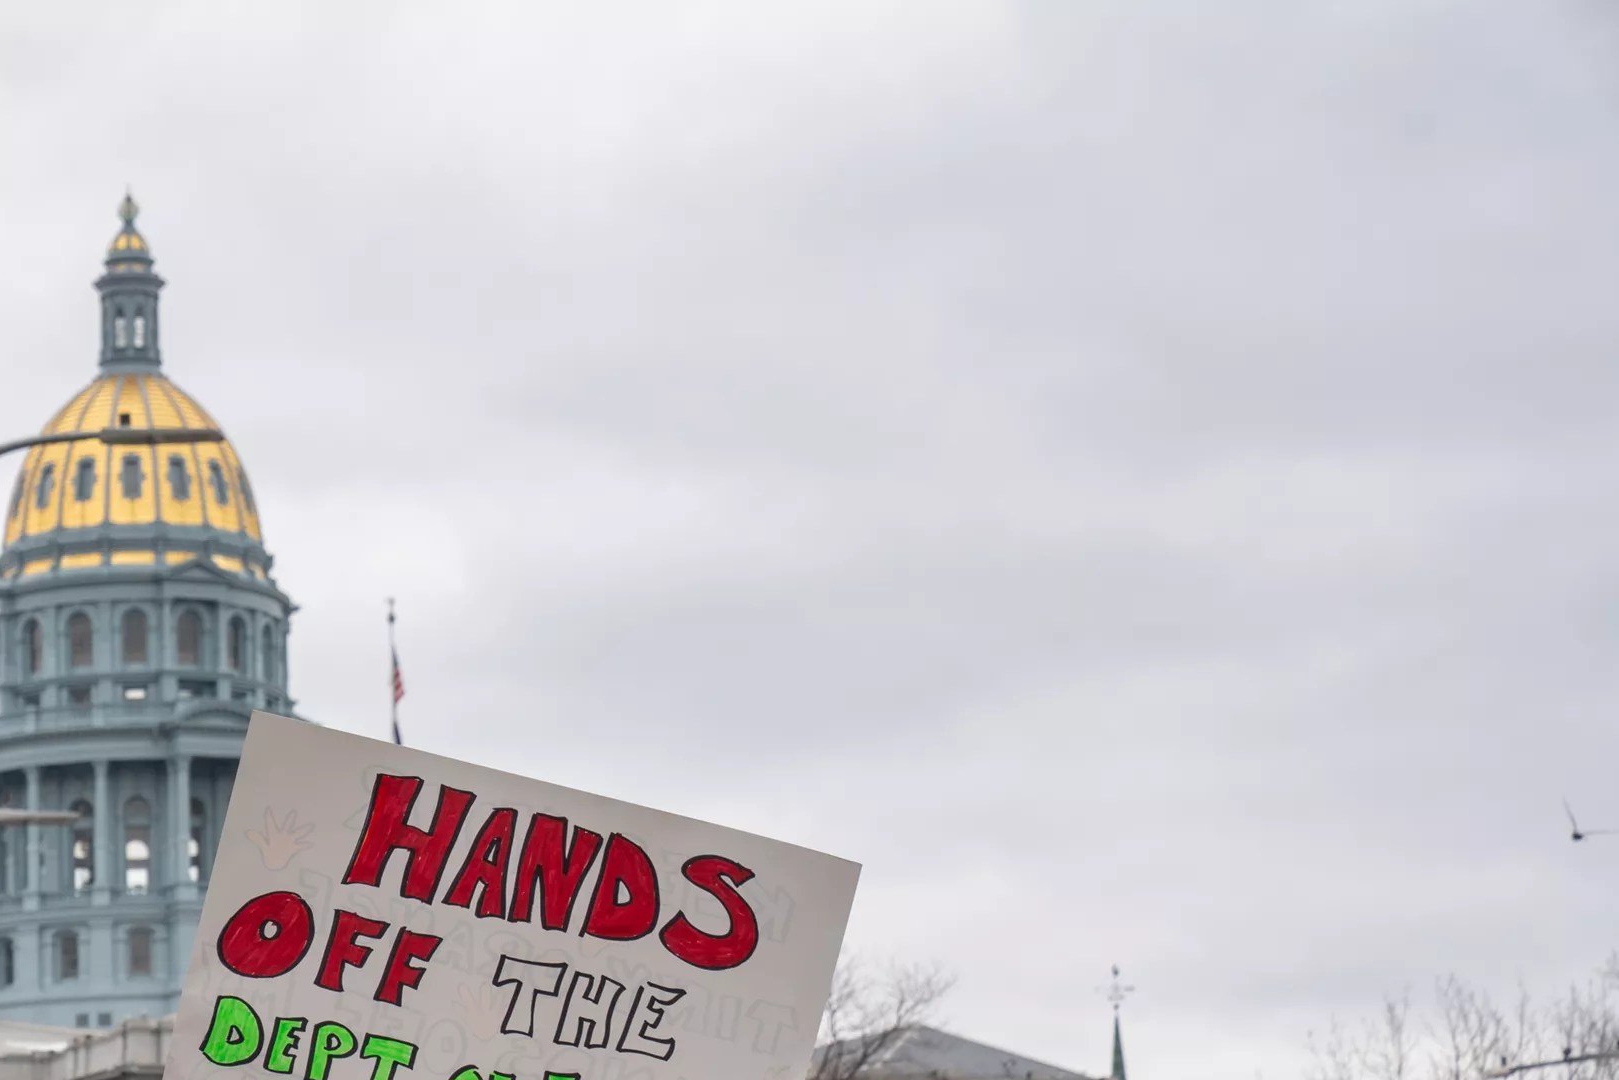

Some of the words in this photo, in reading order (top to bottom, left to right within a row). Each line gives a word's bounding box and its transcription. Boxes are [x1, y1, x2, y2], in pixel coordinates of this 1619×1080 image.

[342, 773, 759, 971] HANDS
[217, 890, 442, 1007] OFF
[492, 953, 686, 1061] THE
